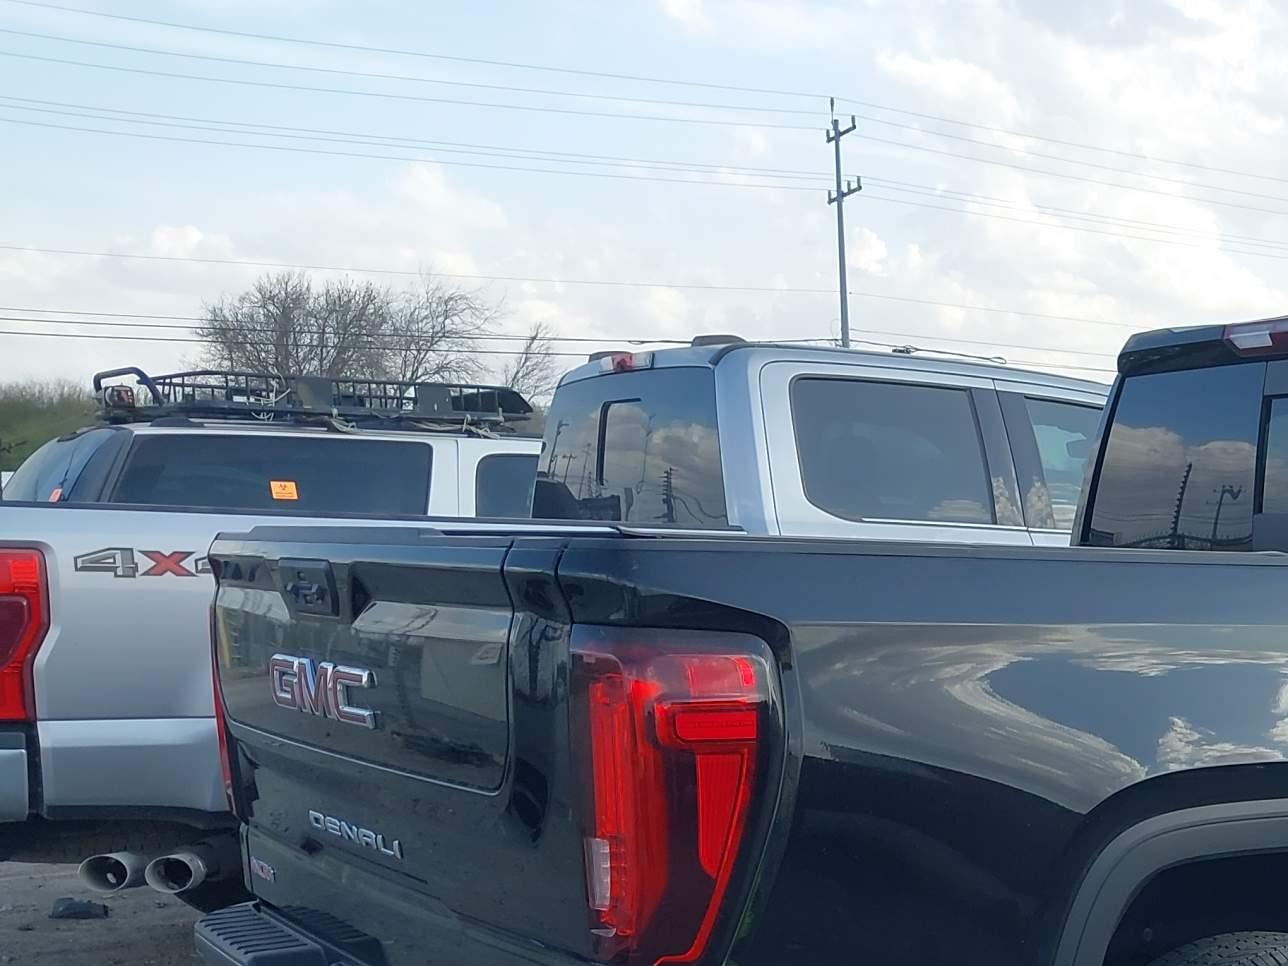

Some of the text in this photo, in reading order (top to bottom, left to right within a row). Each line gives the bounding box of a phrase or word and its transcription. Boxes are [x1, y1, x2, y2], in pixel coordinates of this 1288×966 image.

[74, 547, 212, 578] 4X
[270, 653, 378, 729] GMC
[308, 809, 402, 860] DENALI
